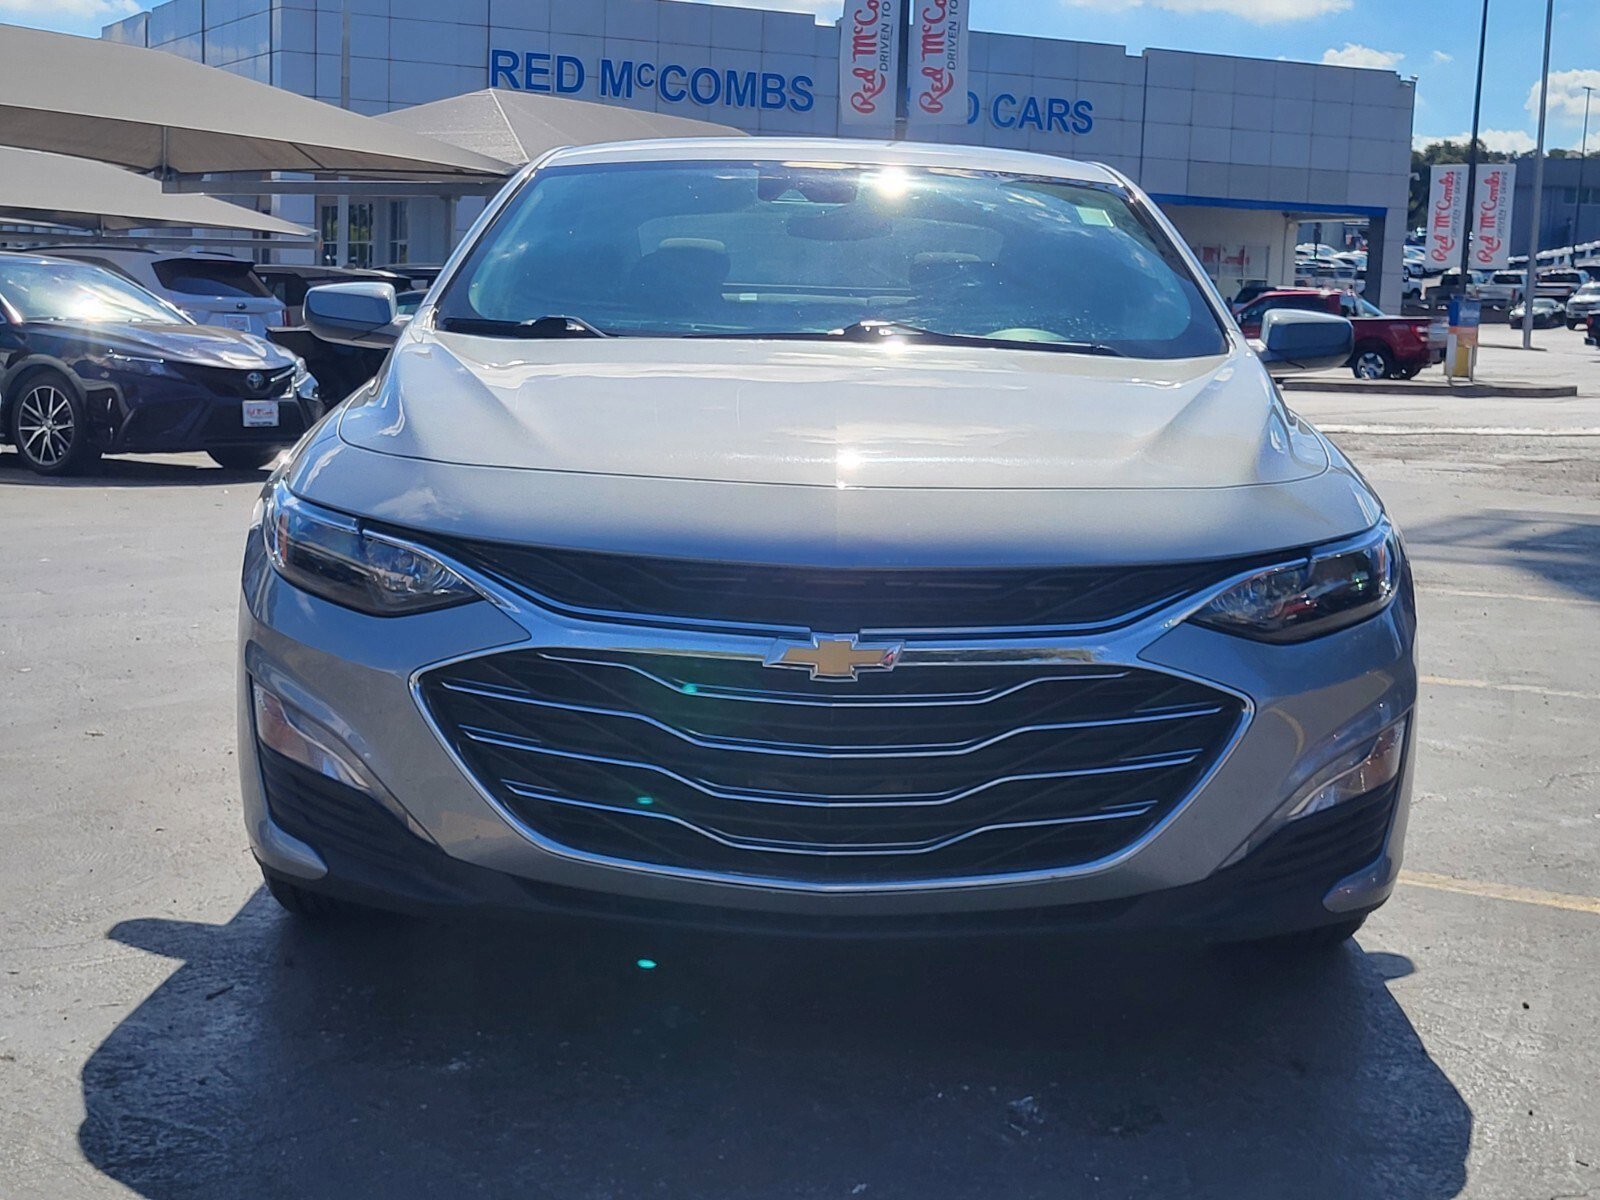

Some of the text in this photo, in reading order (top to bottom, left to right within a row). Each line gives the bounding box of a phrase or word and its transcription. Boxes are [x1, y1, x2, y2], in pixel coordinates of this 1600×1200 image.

[879, 1, 892, 72] DRIVEN TO
[947, 21, 957, 70] DRIVEN
[490, 49, 815, 113] RED McCOMBS
[850, 68, 885, 114] Red
[919, 67, 954, 114] Red
[992, 93, 1094, 135] CARS
[1431, 235, 1455, 261] Red
[1476, 236, 1501, 263] Red
